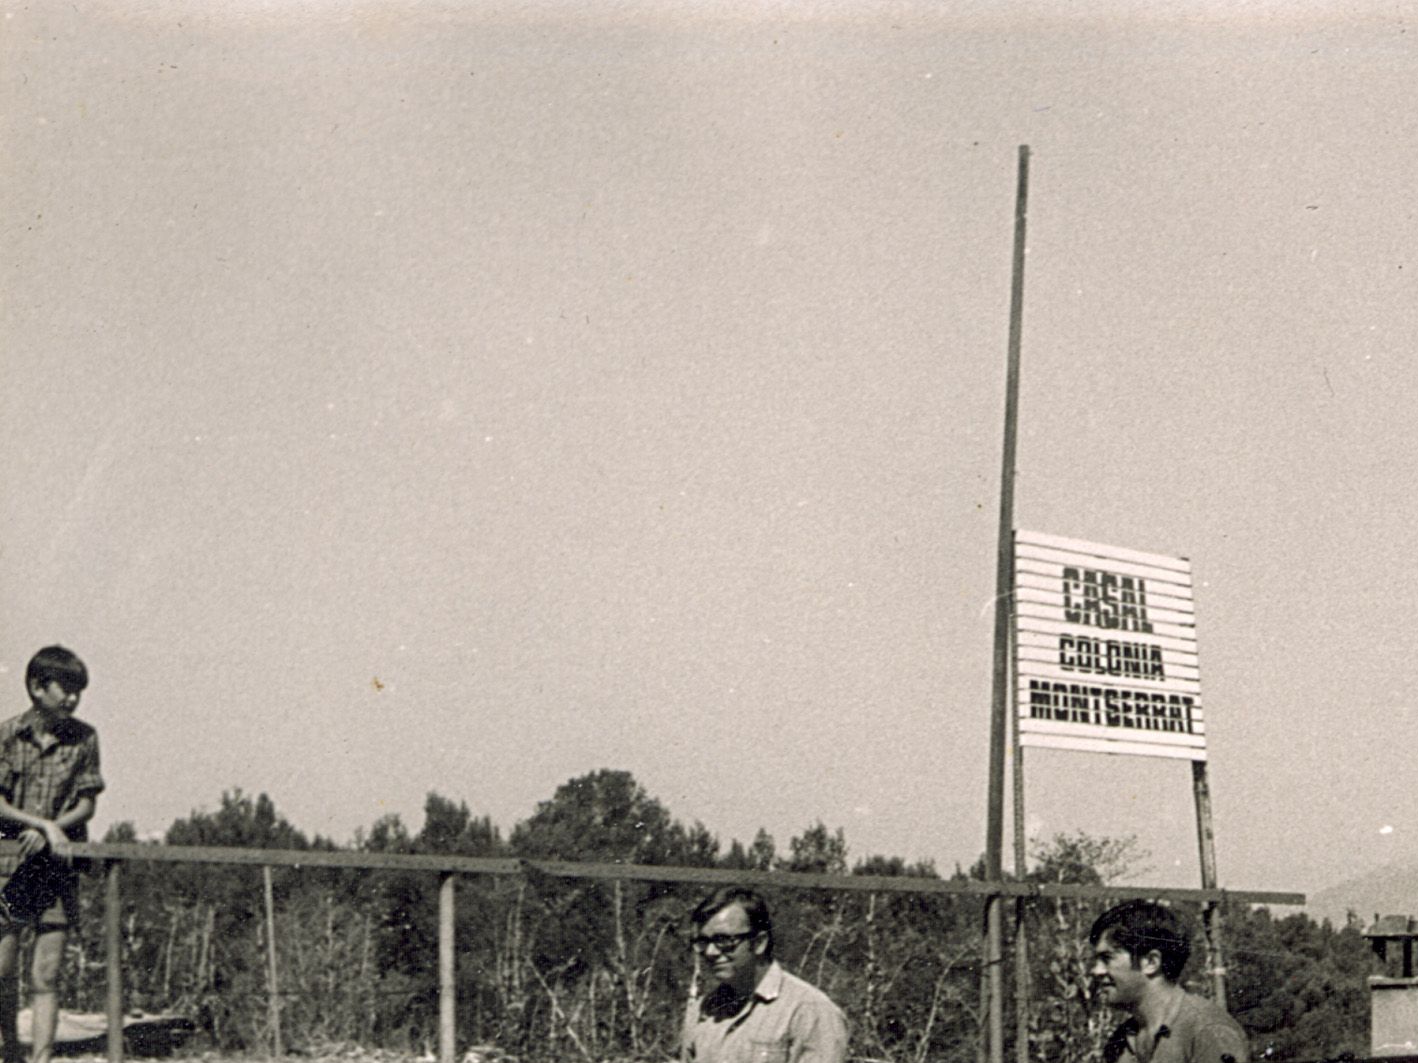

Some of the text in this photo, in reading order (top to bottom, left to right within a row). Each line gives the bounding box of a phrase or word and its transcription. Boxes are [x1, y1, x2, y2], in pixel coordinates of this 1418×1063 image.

[1063, 567, 1154, 634] CASAL
[1059, 633, 1166, 682] COLONIA
[1029, 680, 1194, 734] MONTSERRAT
